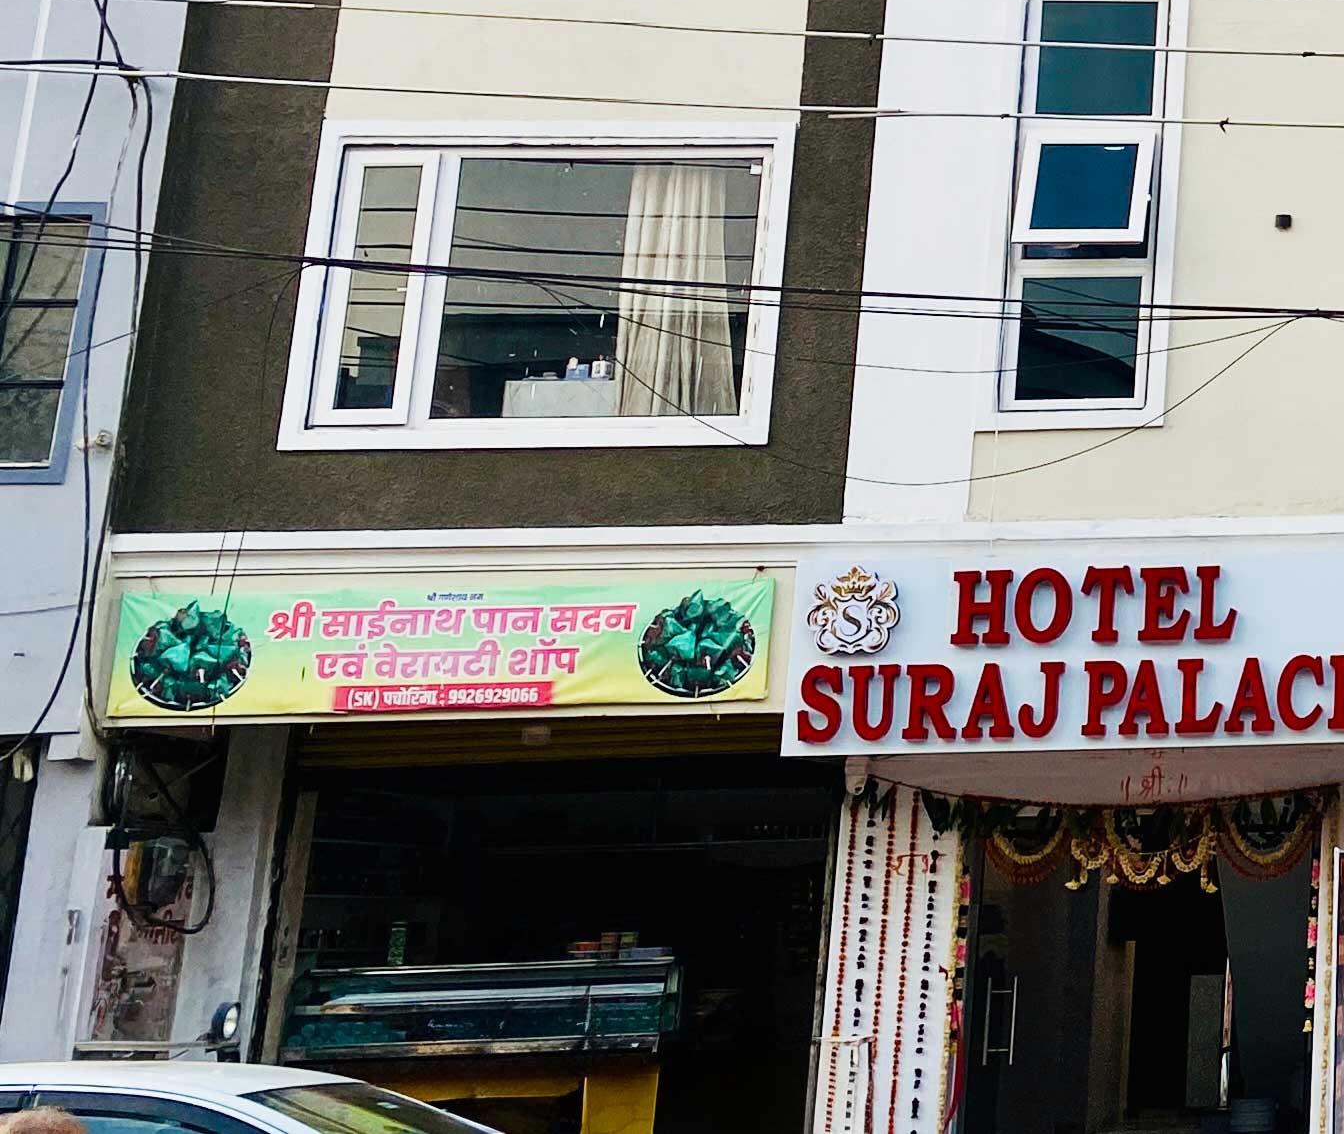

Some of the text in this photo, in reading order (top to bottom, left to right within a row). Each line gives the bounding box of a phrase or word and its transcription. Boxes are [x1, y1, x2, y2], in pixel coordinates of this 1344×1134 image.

[269, 601, 637, 640] श्री साईनाथ पान सदन
[950, 565, 1238, 647] HOTEL
[316, 638, 580, 679] एवं वेरायटी शॉप
[348, 688, 380, 709] (SK)
[447, 687, 539, 705] 9926929066
[797, 661, 1066, 744] SURAJ
